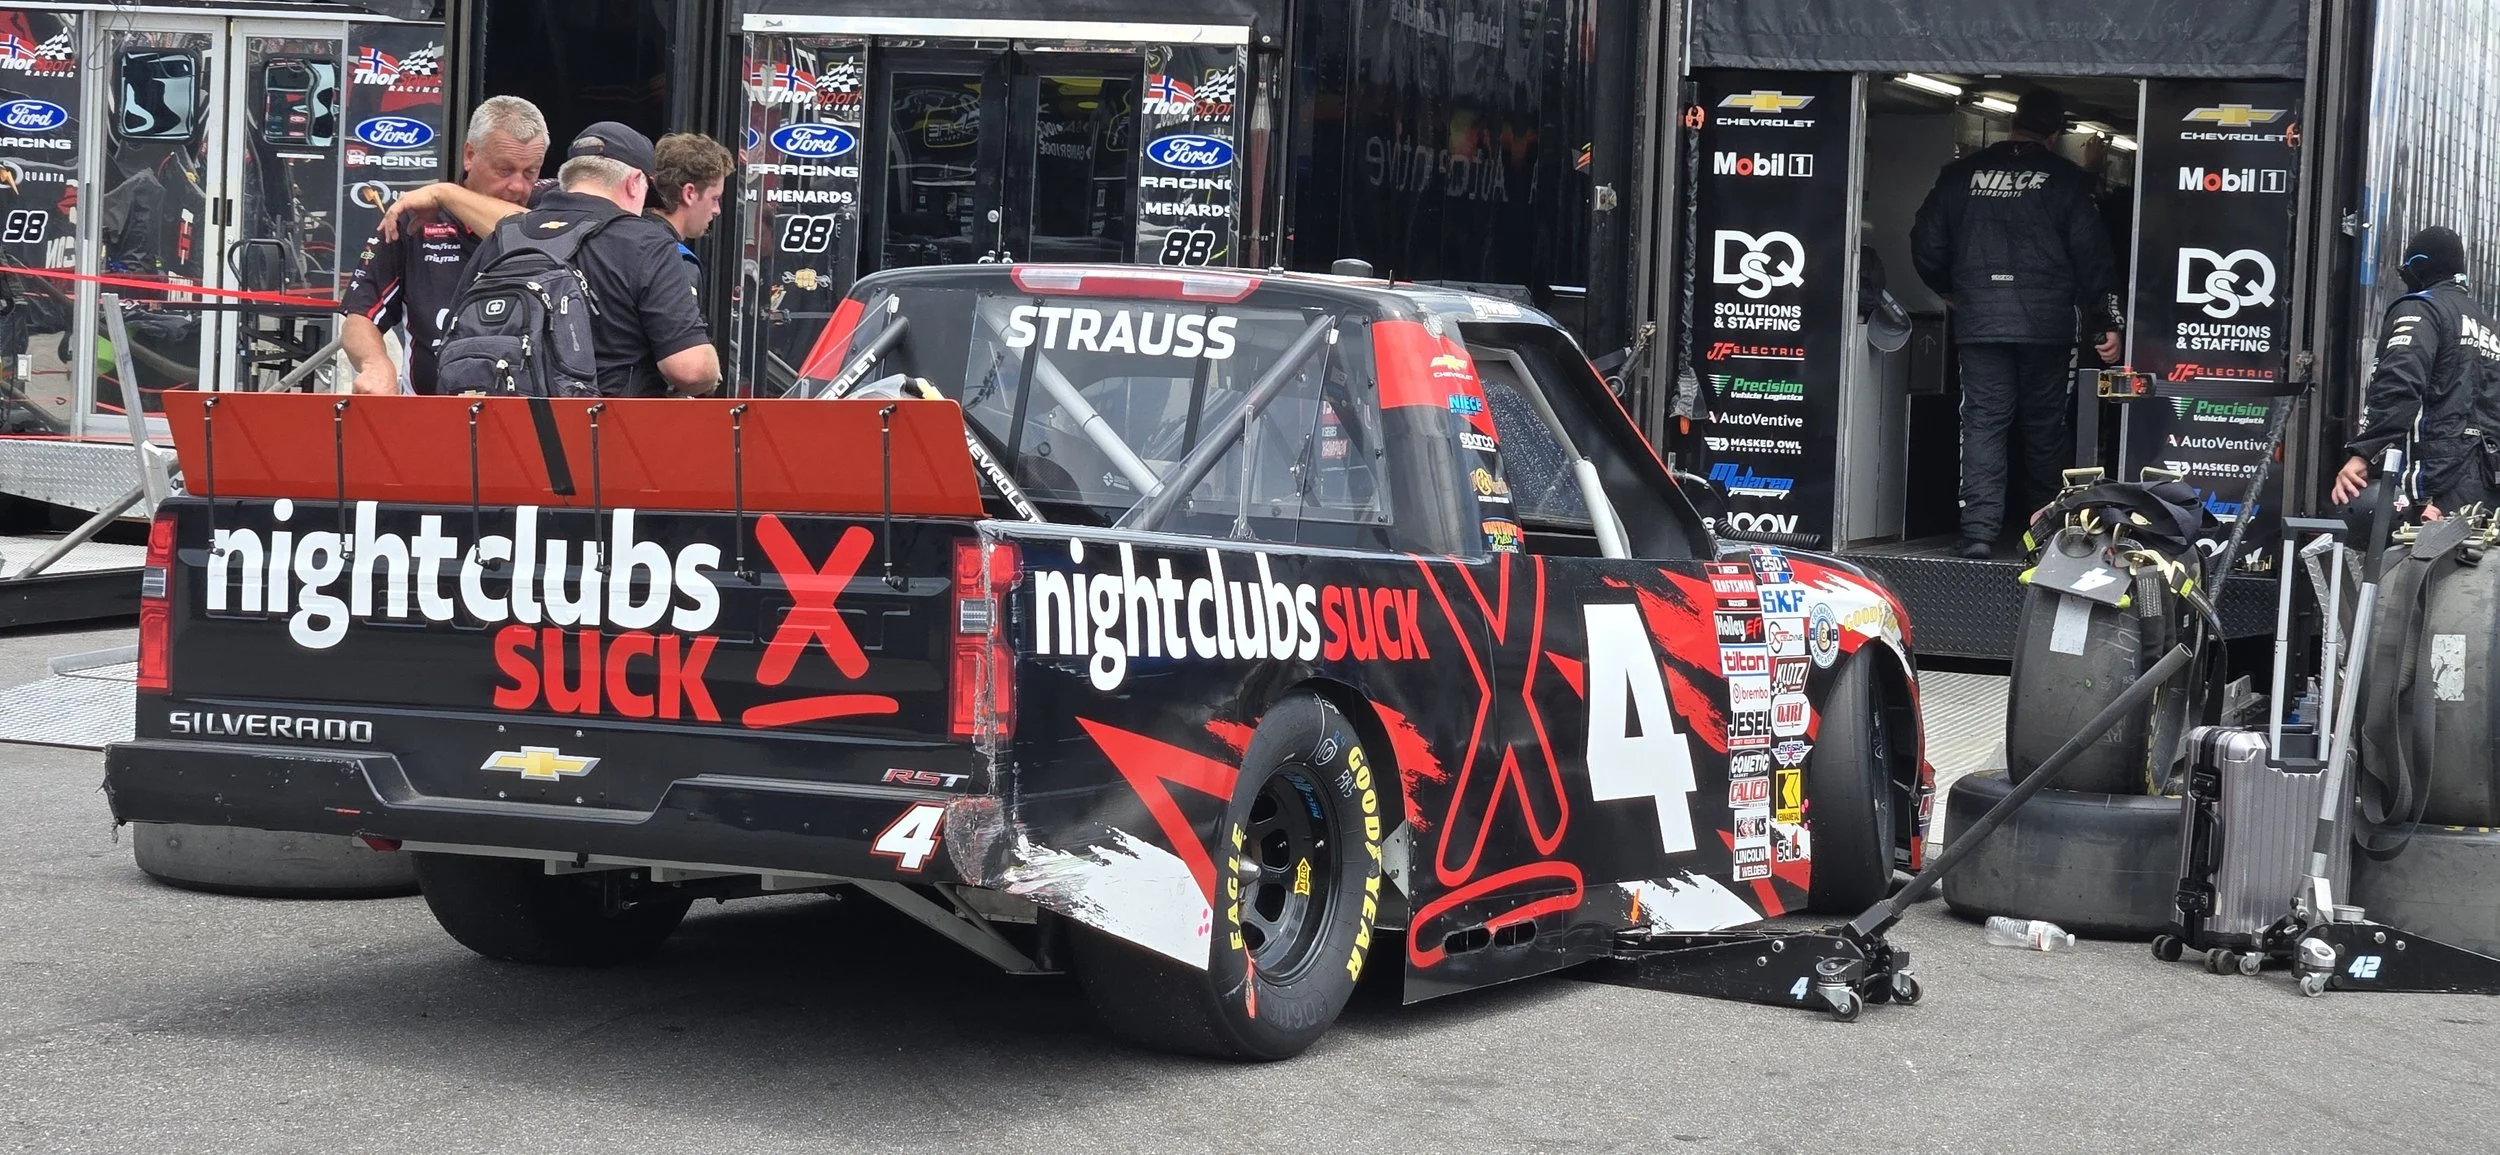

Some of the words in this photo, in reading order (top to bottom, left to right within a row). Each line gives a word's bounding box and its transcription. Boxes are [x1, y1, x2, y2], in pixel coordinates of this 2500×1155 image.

[7, 103, 54, 126] Ford
[804, 103, 860, 111] RACING
[1716, 118, 1815, 127] CHEVROLET
[370, 121, 419, 144] Ford
[786, 127, 839, 152] Ford
[2180, 132, 2286, 142] CHEVROLET
[0, 137, 71, 150] ACING
[1163, 139, 1220, 165] Ford
[348, 155, 438, 168] RACING
[1714, 152, 1784, 176] Mobil
[25, 171, 64, 182] QUANTA
[762, 164, 859, 178] RACING
[2178, 167, 2255, 192] Mobil
[767, 189, 852, 204] MENARDS
[3, 210, 48, 243] 98
[781, 215, 834, 253] 88
[1159, 229, 1216, 266] 88
[1714, 302, 1802, 318] SOLUTIONS
[1005, 305, 1238, 360] STRAUSS
[1714, 316, 1724, 329] &
[1727, 317, 1801, 331] STAFFING
[2177, 322, 2271, 338] SOLUTIONS
[1733, 346, 1804, 356] ELECTRIC
[2176, 337, 2187, 349] &
[2191, 338, 2270, 352] STAFFING
[2197, 367, 2273, 378] ELECTRIC
[1733, 378, 1803, 394] Precision
[1449, 395, 1482, 411] NIECE
[1731, 391, 1762, 399] Vehicle
[1763, 393, 1803, 401] Logistics
[1720, 412, 1803, 428] AutoVentive
[2193, 414, 2227, 423] Vehicle
[1460, 432, 1494, 449] sparco
[1731, 438, 1774, 448] MASKED
[1777, 440, 1802, 449] OWL
[1731, 447, 1802, 455] TECHNOLOGIES
[2193, 462, 2239, 472] MASKED
[1761, 556, 1782, 571] 250
[206, 498, 721, 649] nightclubs
[1712, 579, 1757, 593] CRAFTSMAN
[1762, 590, 1805, 613] SKF
[1035, 537, 1321, 691] nightclubs
[1716, 615, 1746, 641] Holley
[1724, 651, 1766, 672] tilton
[1776, 663, 1807, 686] KLOTZ
[1741, 687, 1768, 700] brembo
[170, 711, 373, 743] SILVERADO
[1584, 604, 1697, 854] 4
[1729, 711, 1771, 737] JESEL
[1731, 754, 1769, 774] COMETIC
[881, 768, 970, 787] RST
[1731, 780, 1768, 802] CALICO
[870, 801, 947, 872] 4
[1346, 746, 1382, 982] GOODYEAR
[1735, 848, 1764, 864] LINCOLN
[1298, 866, 1309, 891] AERO
[1741, 864, 1768, 877] WELDERS
[1227, 822, 1244, 951] EAGLE
[2348, 955, 2381, 978] 42
[1790, 976, 1809, 1000] 4
